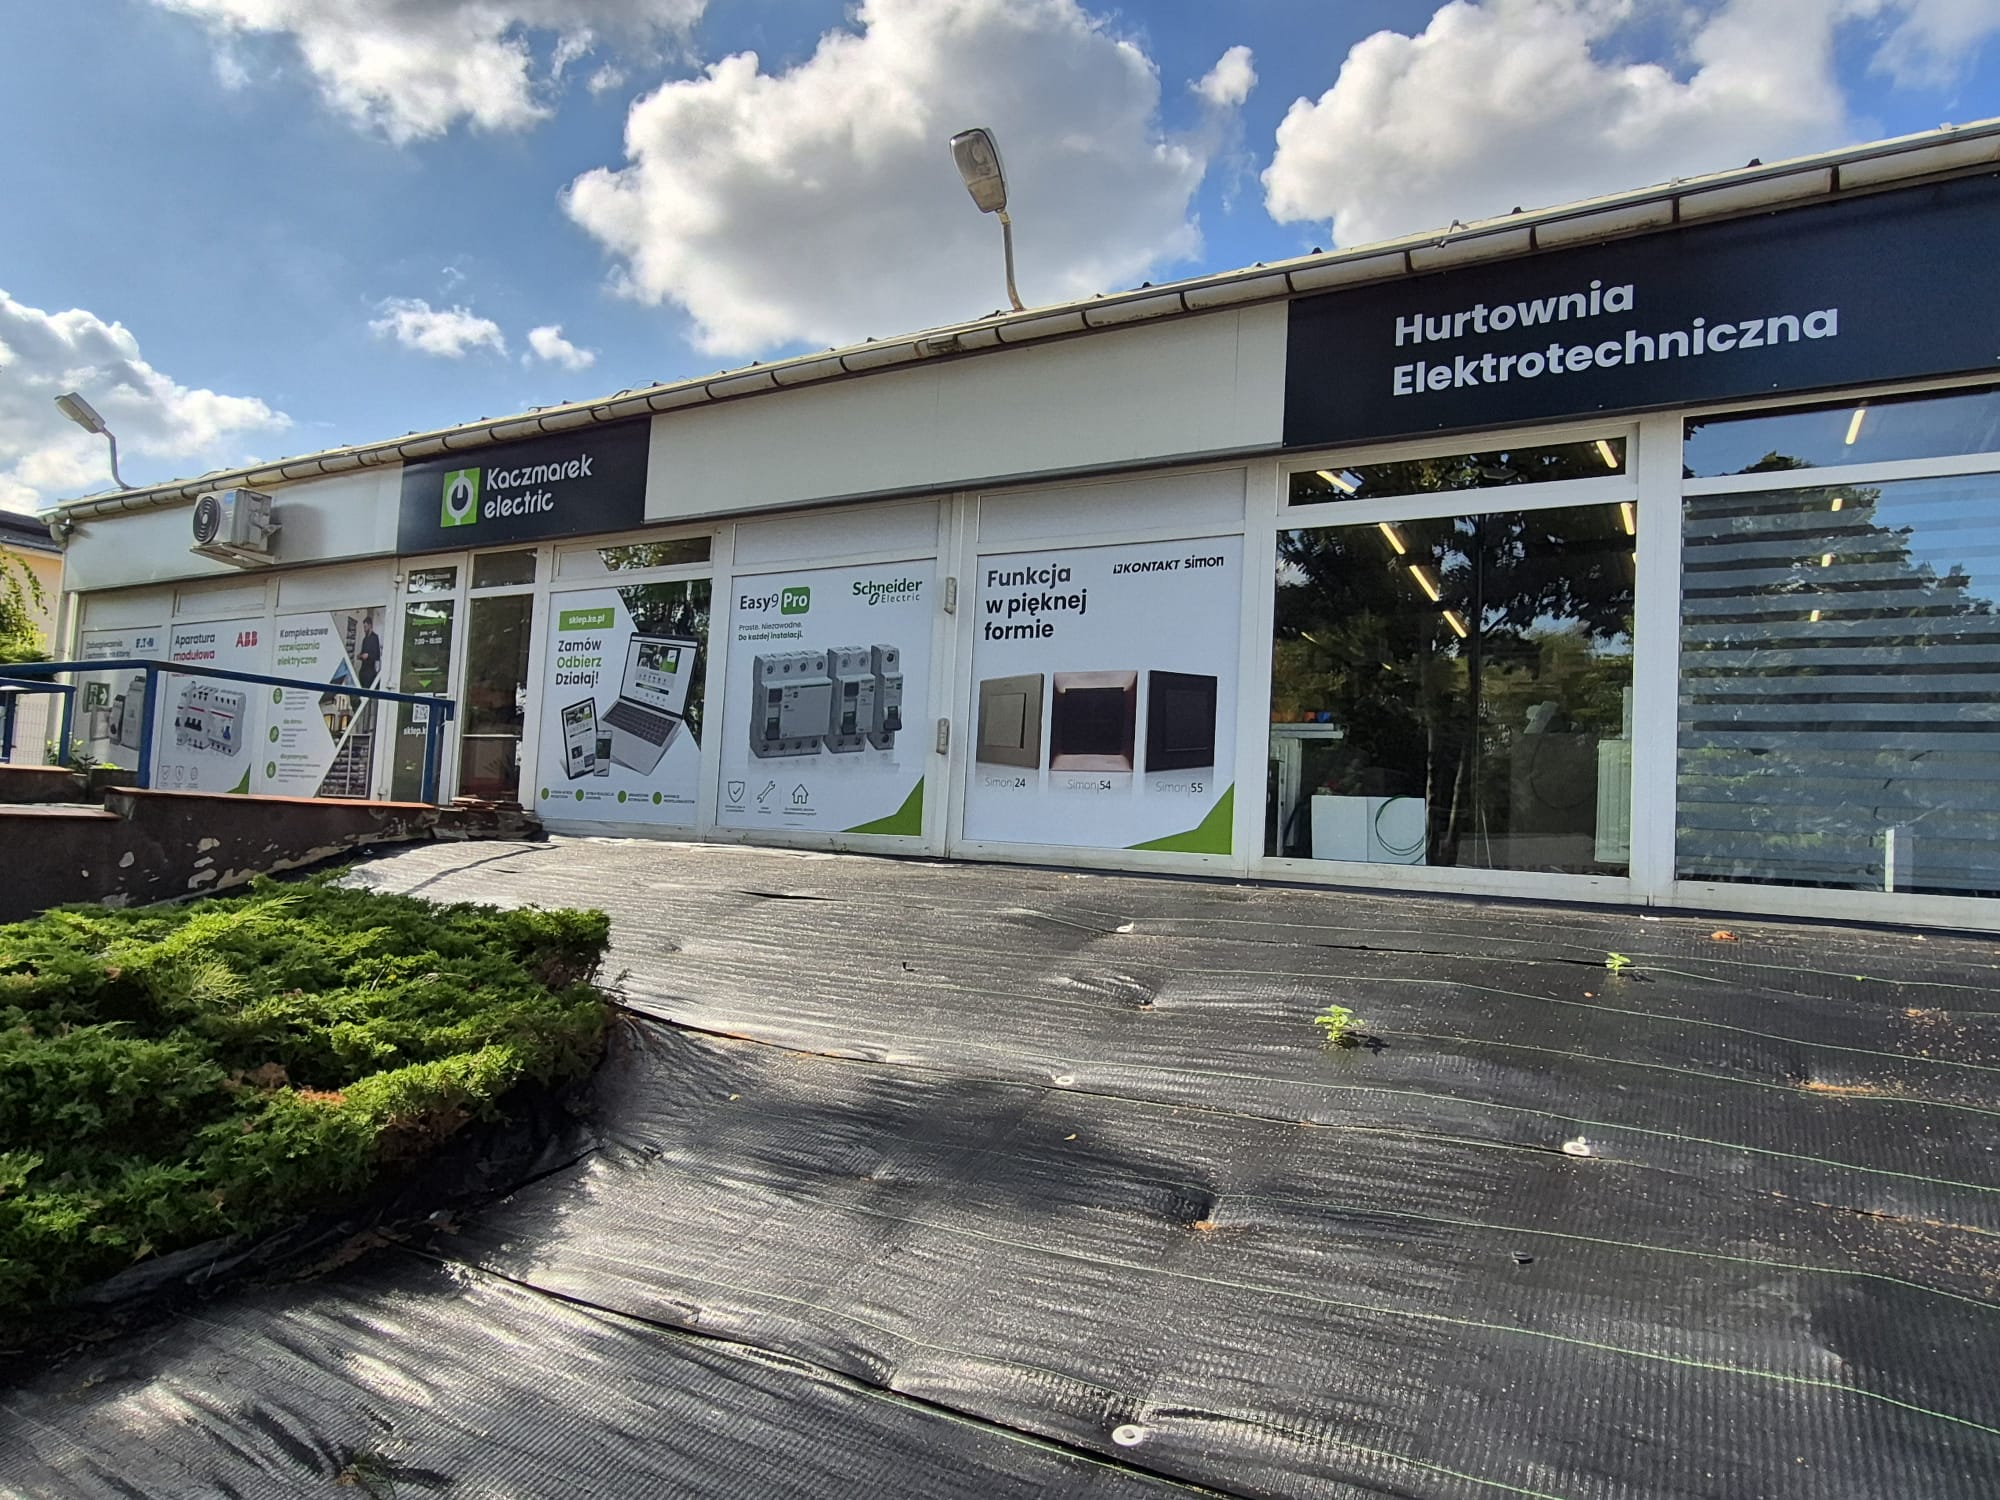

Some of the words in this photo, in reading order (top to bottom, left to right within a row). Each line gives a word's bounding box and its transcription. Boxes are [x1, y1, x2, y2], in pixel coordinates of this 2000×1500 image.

[1394, 279, 1635, 347] Hurtownia
[1392, 307, 1839, 396] Elektrotechniczna
[486, 453, 593, 491] Kaczmarek
[484, 489, 554, 519] electric
[1123, 560, 1180, 574] KONTAKT
[1184, 554, 1224, 569] simon
[987, 563, 1071, 589] Funkcja
[852, 578, 923, 596] Schneider
[740, 593, 779, 612] Easy9
[783, 592, 808, 608] Pro
[881, 593, 920, 604] Electric
[986, 599, 1004, 614] w
[1007, 588, 1087, 619] pięknej
[279, 627, 329, 640] Kompleksowe
[985, 618, 1054, 640] formie
[175, 633, 216, 648] Aparatura
[235, 631, 258, 648] ABB
[558, 637, 602, 652] Zamów
[173, 649, 215, 662] modułowa
[277, 656, 318, 668] elektryczne
[556, 654, 602, 669] Odbierz
[555, 670, 599, 689] Działaj!
